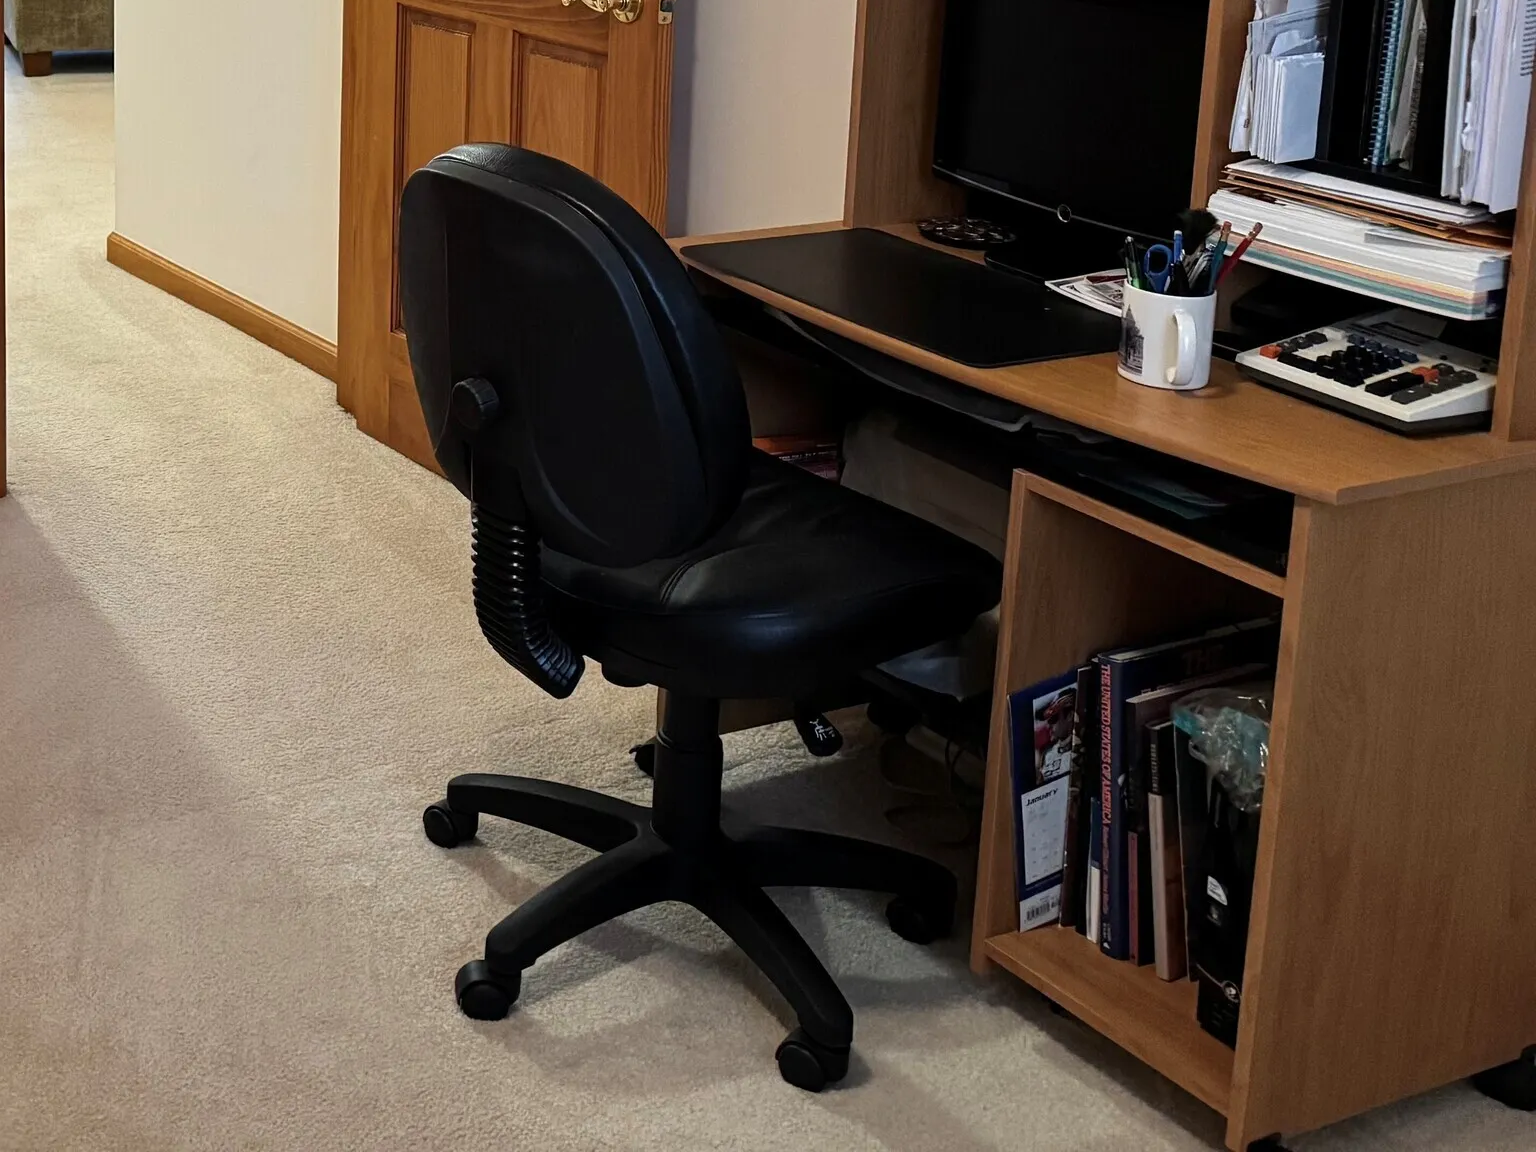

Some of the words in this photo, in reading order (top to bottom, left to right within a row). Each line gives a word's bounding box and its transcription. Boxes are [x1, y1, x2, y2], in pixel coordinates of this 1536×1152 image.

[1101, 686, 1111, 724] UNITED
[1101, 725, 1111, 763] STATES
[1025, 788, 1059, 806] January
[1101, 777, 1112, 825] AMERICA
